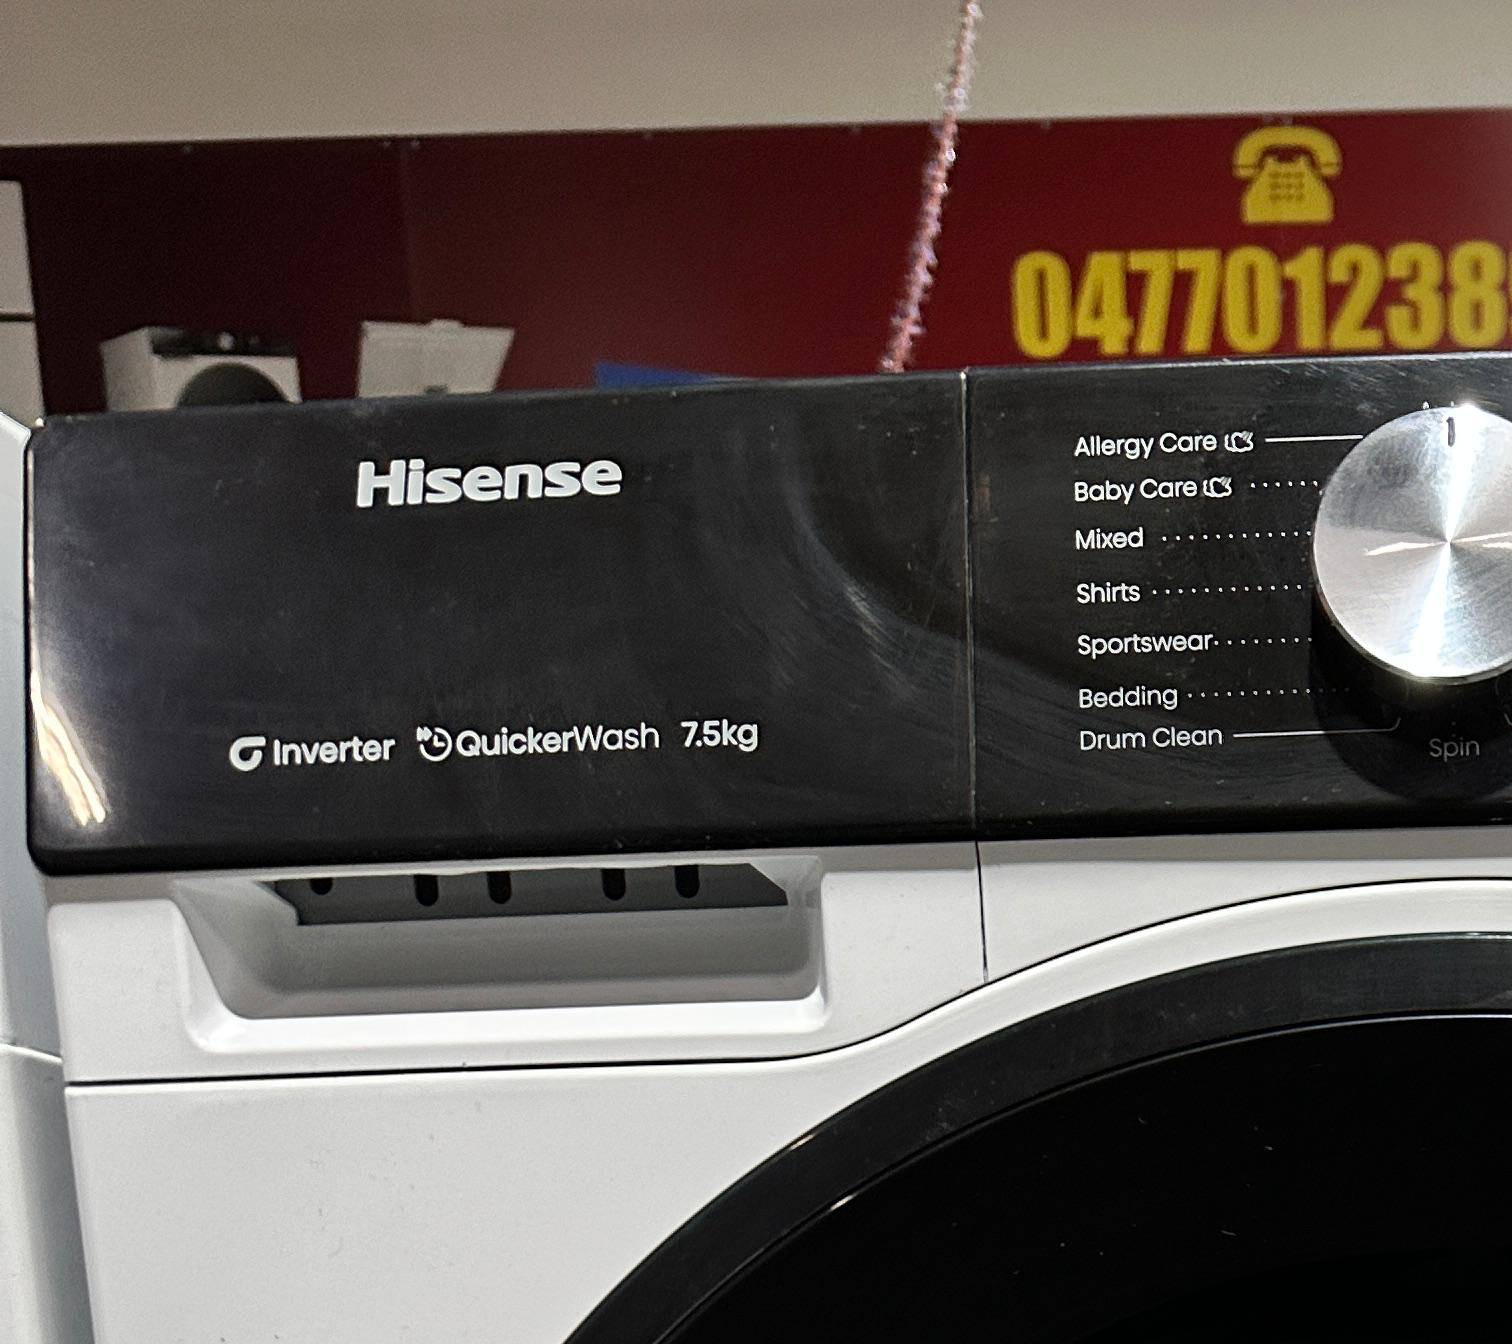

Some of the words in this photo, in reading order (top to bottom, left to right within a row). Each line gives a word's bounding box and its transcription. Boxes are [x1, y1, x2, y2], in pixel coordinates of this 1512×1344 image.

[1073, 435, 1154, 460] Allergy
[1159, 432, 1218, 453] Care
[356, 458, 623, 508] Hisense
[1073, 480, 1135, 505] Baby
[1139, 478, 1198, 499] Care
[1075, 526, 1144, 550] Mixed
[1076, 581, 1141, 604] Shirts
[1077, 633, 1214, 660] Sportswear
[1078, 685, 1178, 711] Bedding
[273, 734, 396, 766] Inverter
[455, 722, 660, 758] QuickerWash
[680, 719, 758, 753] 7.5kg
[1079, 730, 1146, 751] Drum
[1152, 726, 1224, 748] Clean
[1429, 737, 1480, 762] Spin
